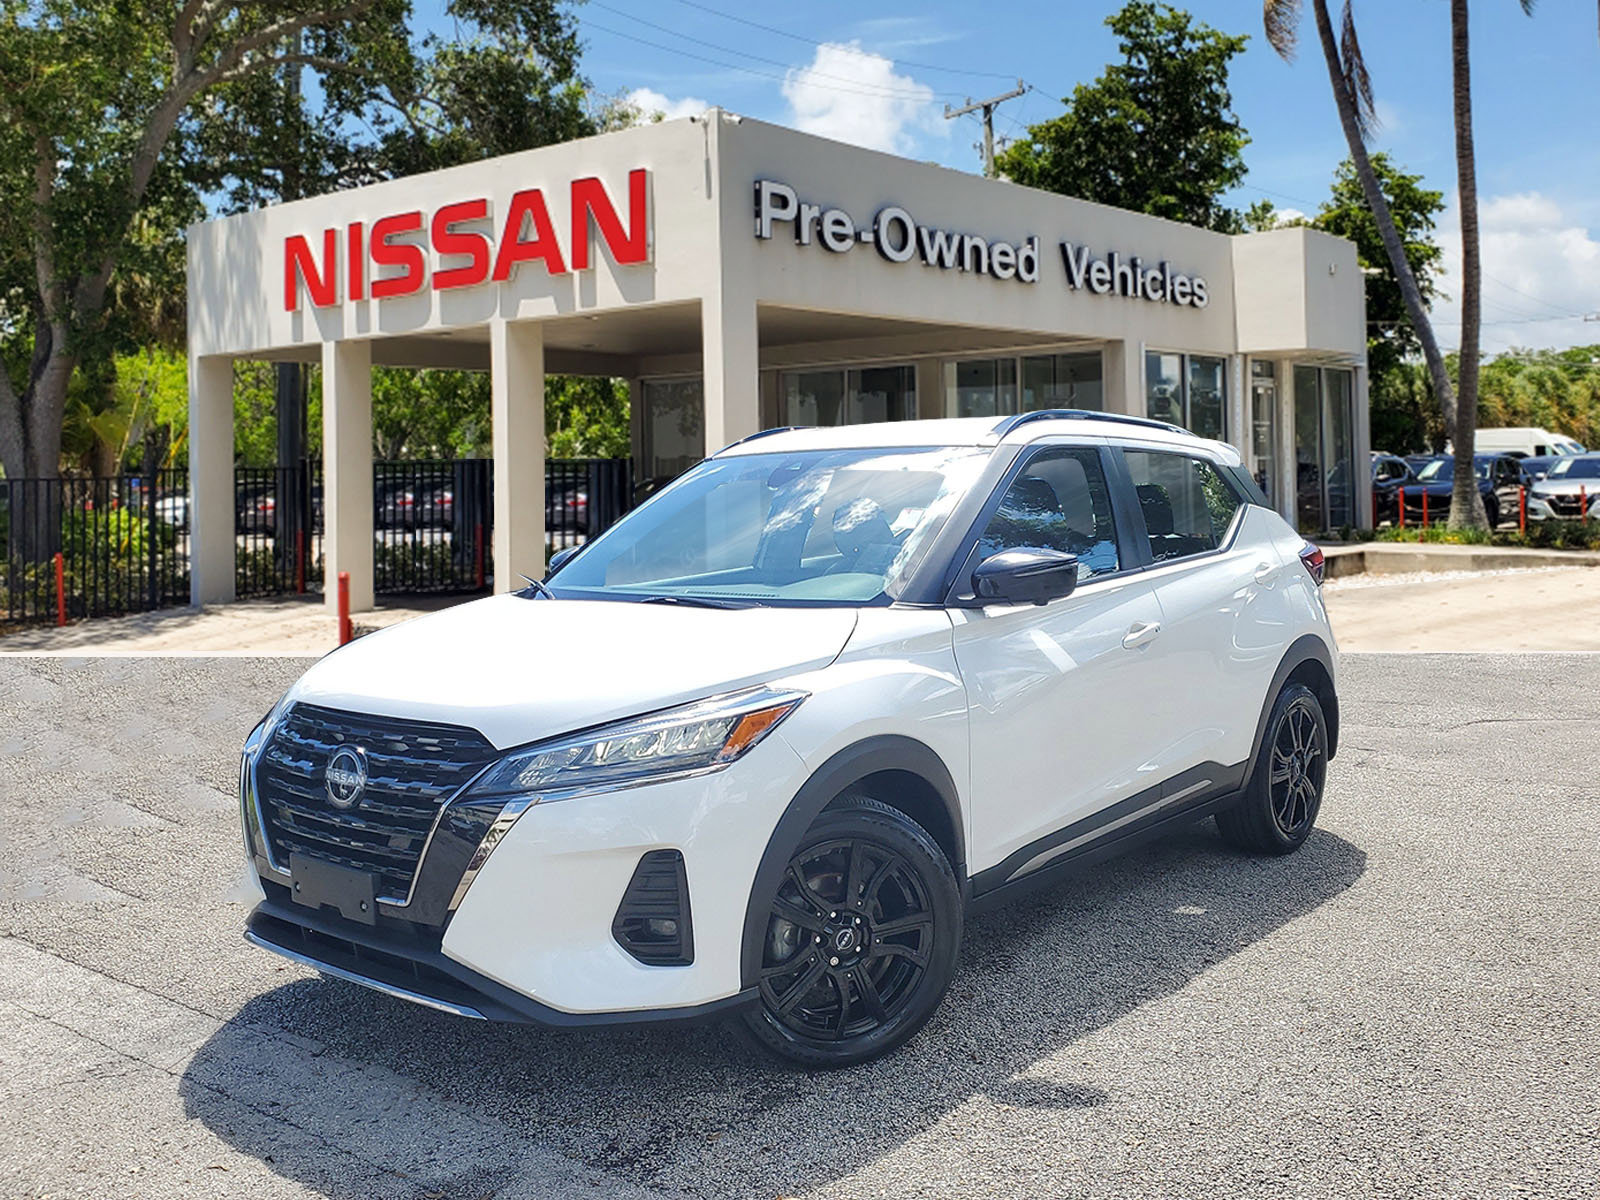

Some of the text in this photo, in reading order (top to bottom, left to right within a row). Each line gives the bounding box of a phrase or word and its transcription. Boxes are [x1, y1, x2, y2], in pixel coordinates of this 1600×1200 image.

[285, 168, 647, 312] NISSAN
[755, 179, 1209, 308] Pre-Owned Vehicles
